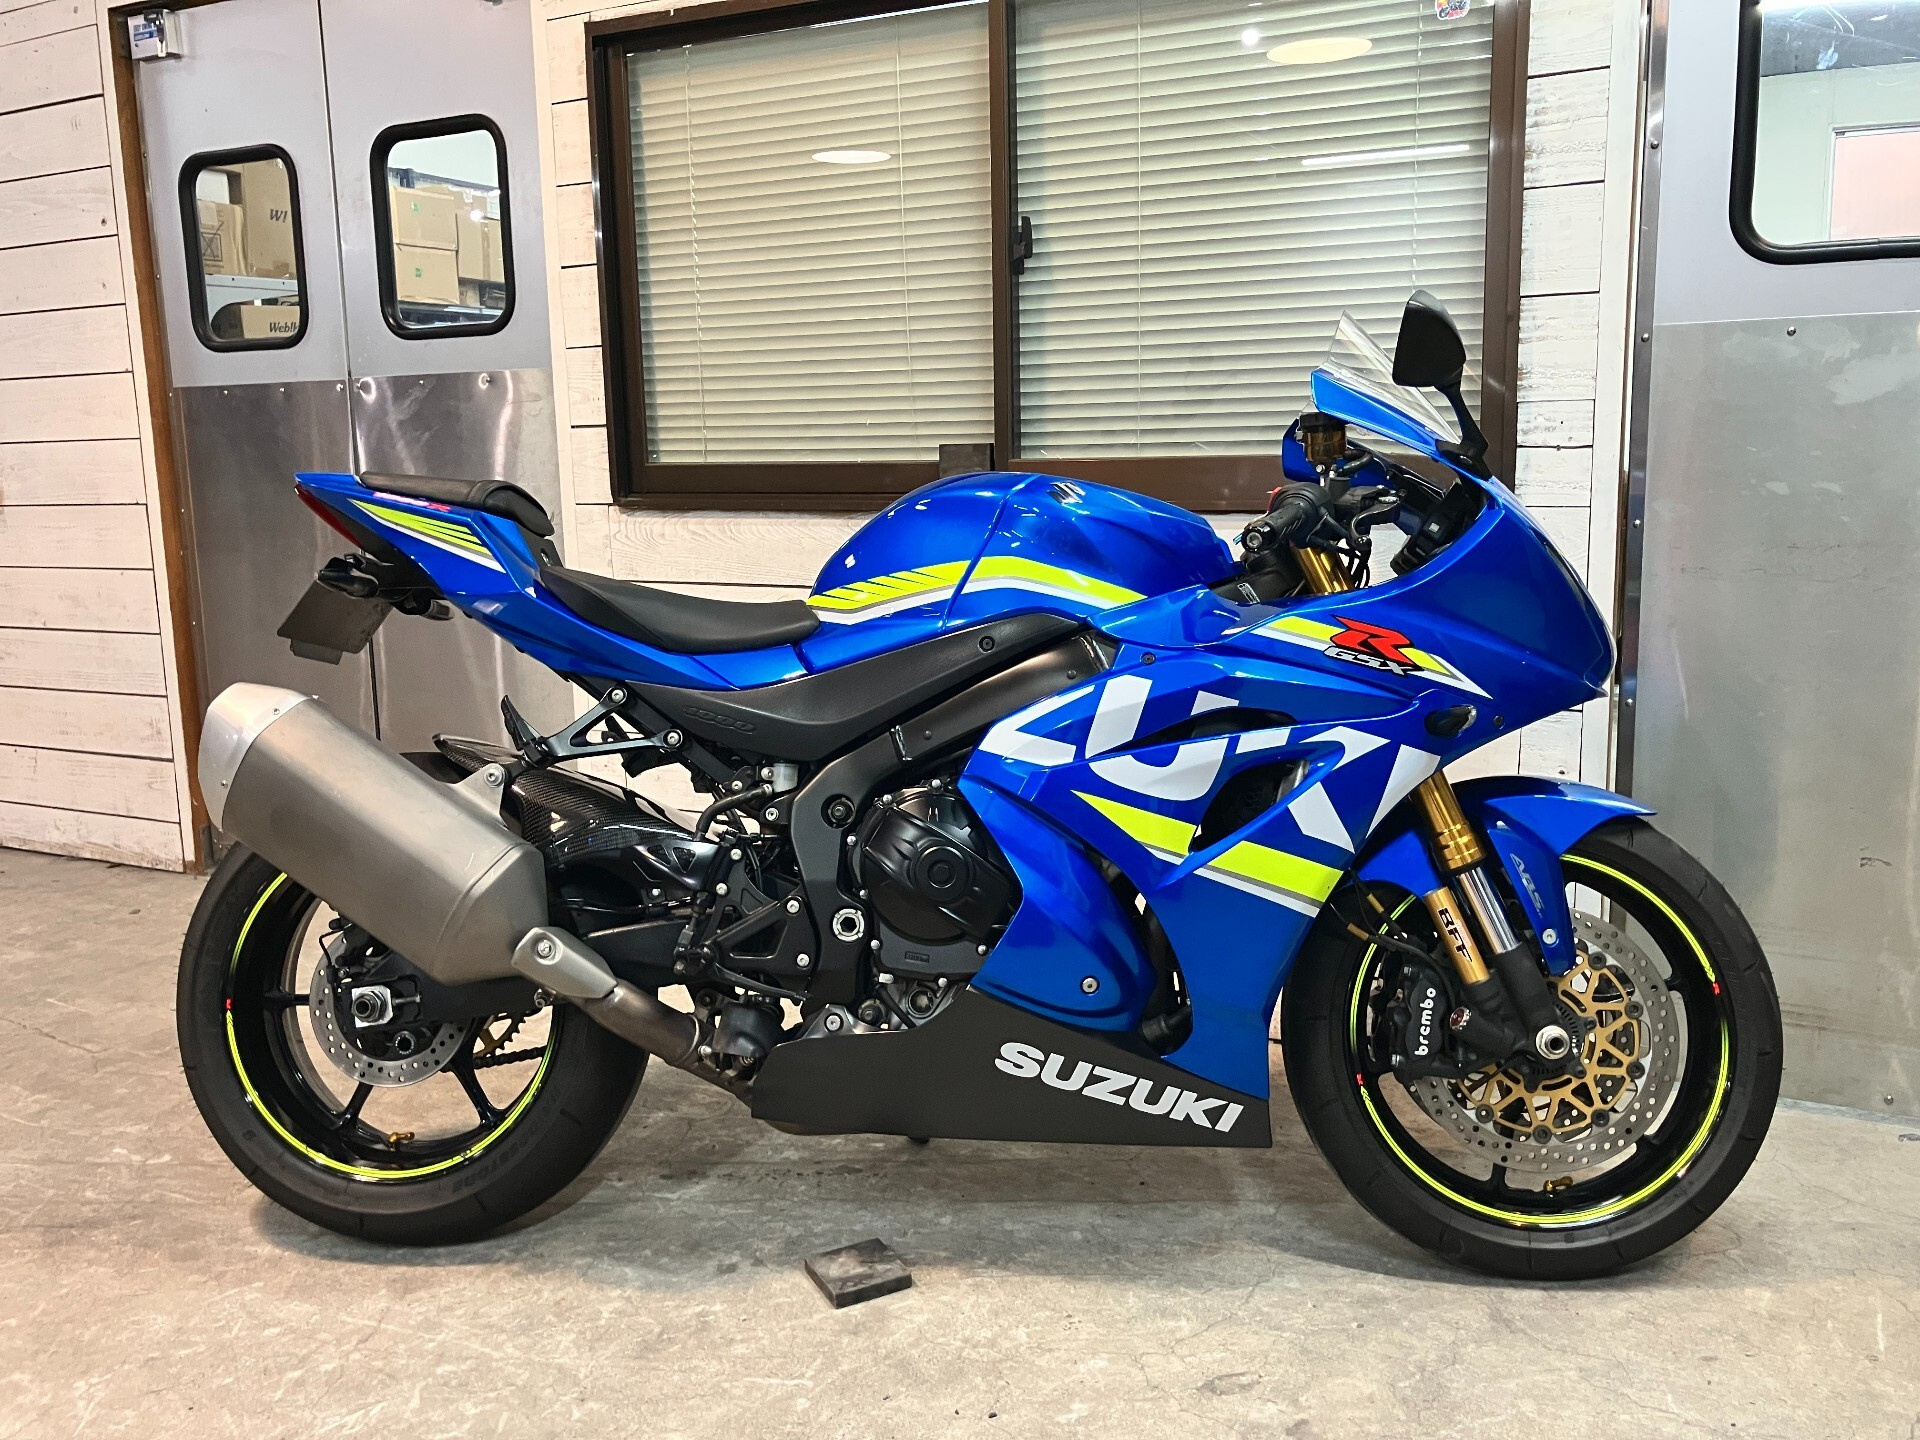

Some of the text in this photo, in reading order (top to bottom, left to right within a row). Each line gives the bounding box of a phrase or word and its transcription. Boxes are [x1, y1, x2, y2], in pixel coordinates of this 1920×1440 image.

[1323, 645, 1414, 676] GSX
[1509, 853, 1545, 918] ABS
[1437, 907, 1473, 963] BFF
[1414, 987, 1437, 1056] brembo
[994, 1041, 1245, 1133] SUZUKI
